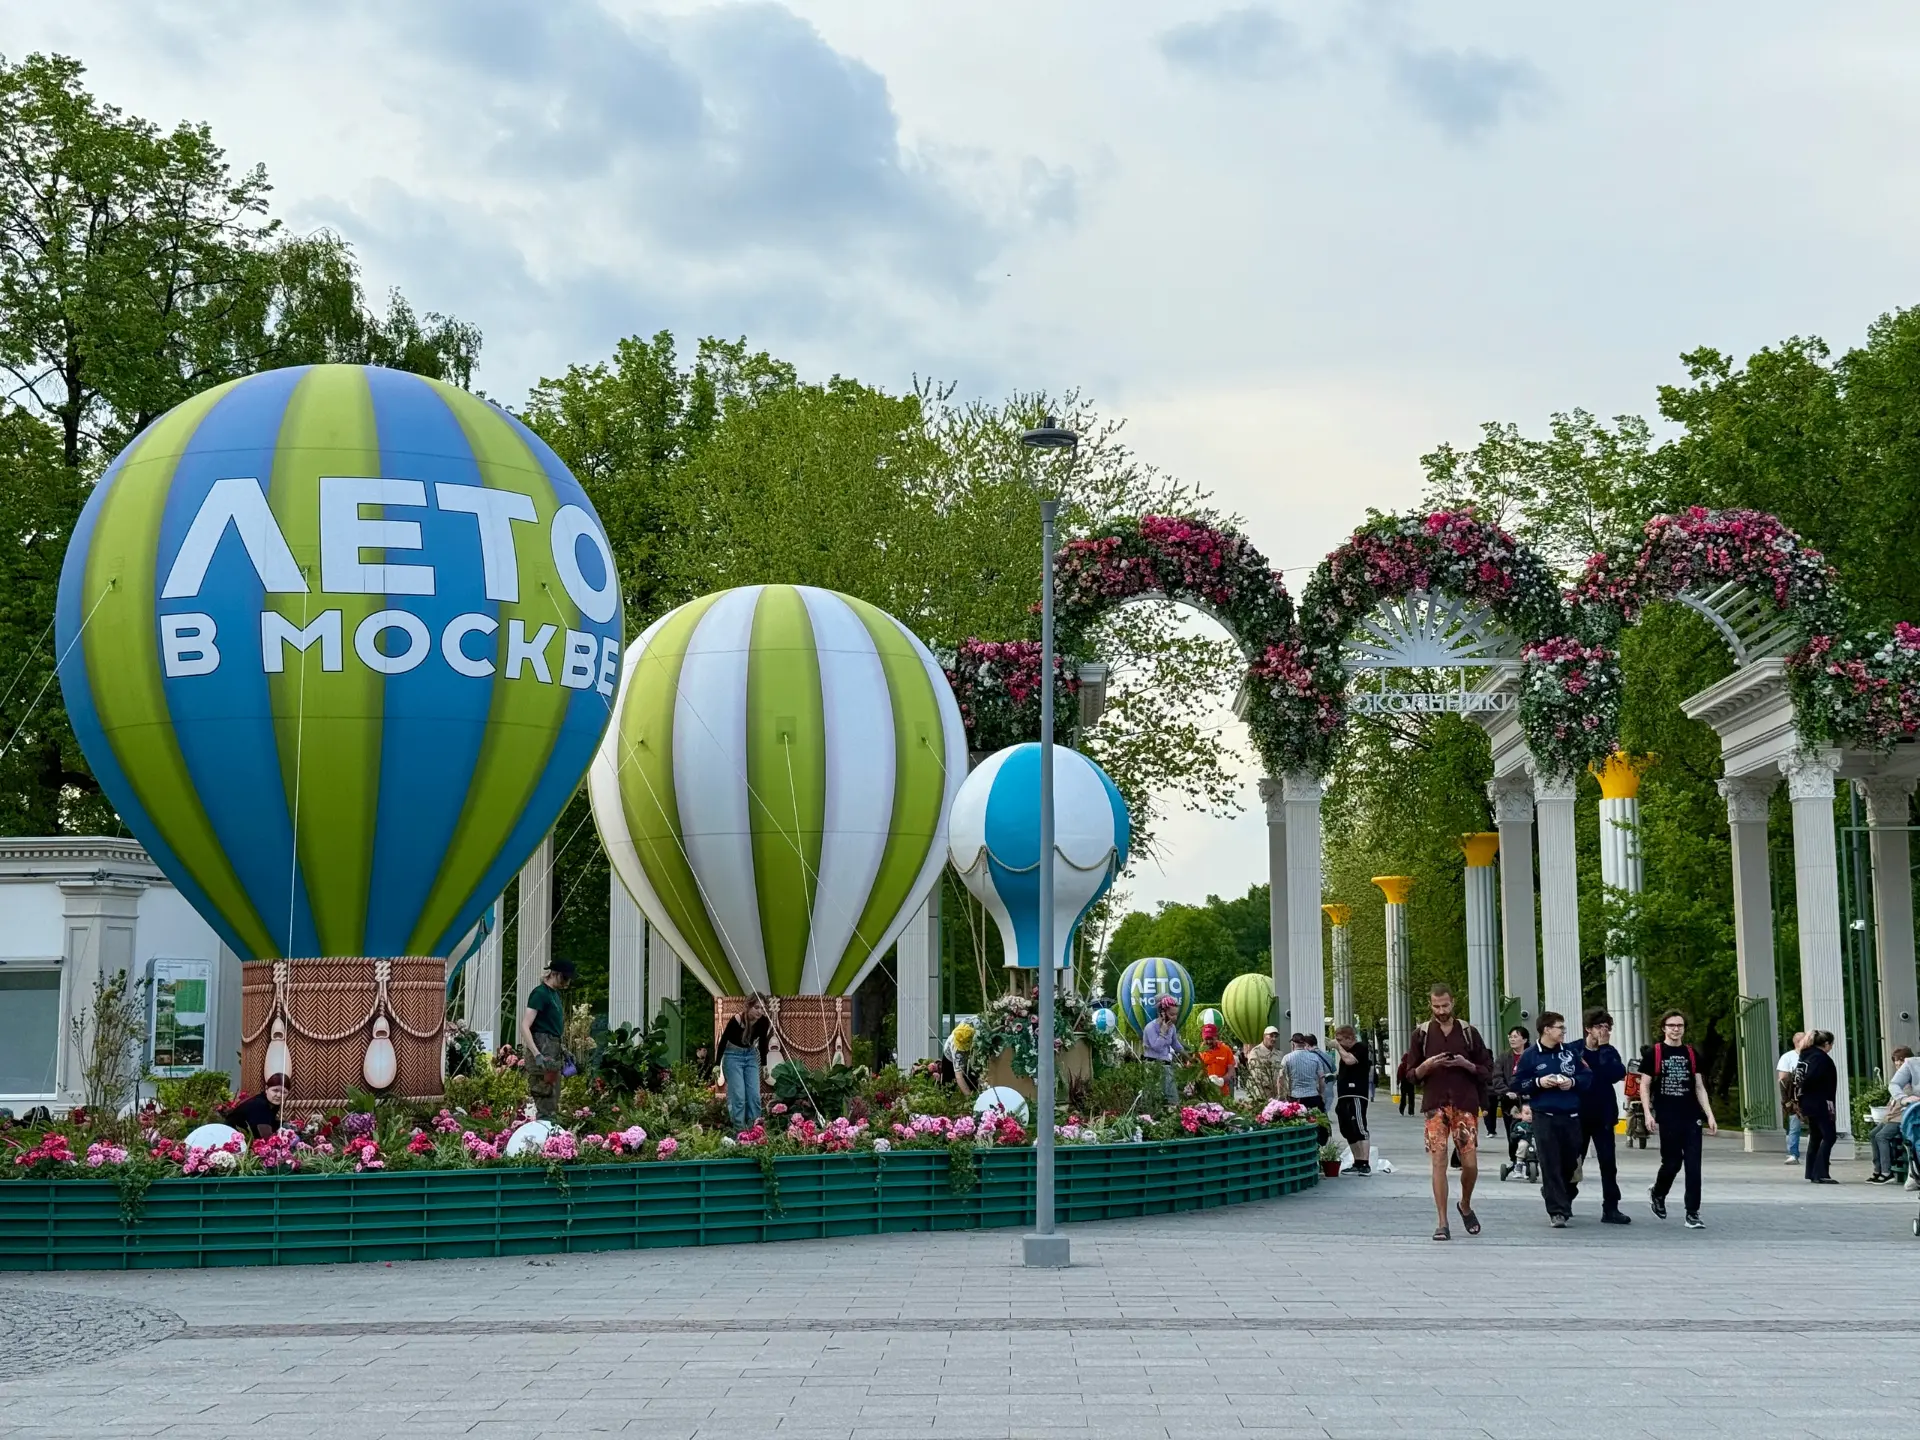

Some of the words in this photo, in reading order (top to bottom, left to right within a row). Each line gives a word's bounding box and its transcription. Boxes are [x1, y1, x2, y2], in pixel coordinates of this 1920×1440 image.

[160, 476, 617, 624] ЛЕТО
[159, 611, 221, 679] В
[260, 608, 620, 697] МОСКВЕ
[1352, 693, 1519, 712] ОКОЛЬНИКИ
[1131, 977, 1182, 994] ЛЕТО
[1140, 997, 1182, 1006] МОЕ
